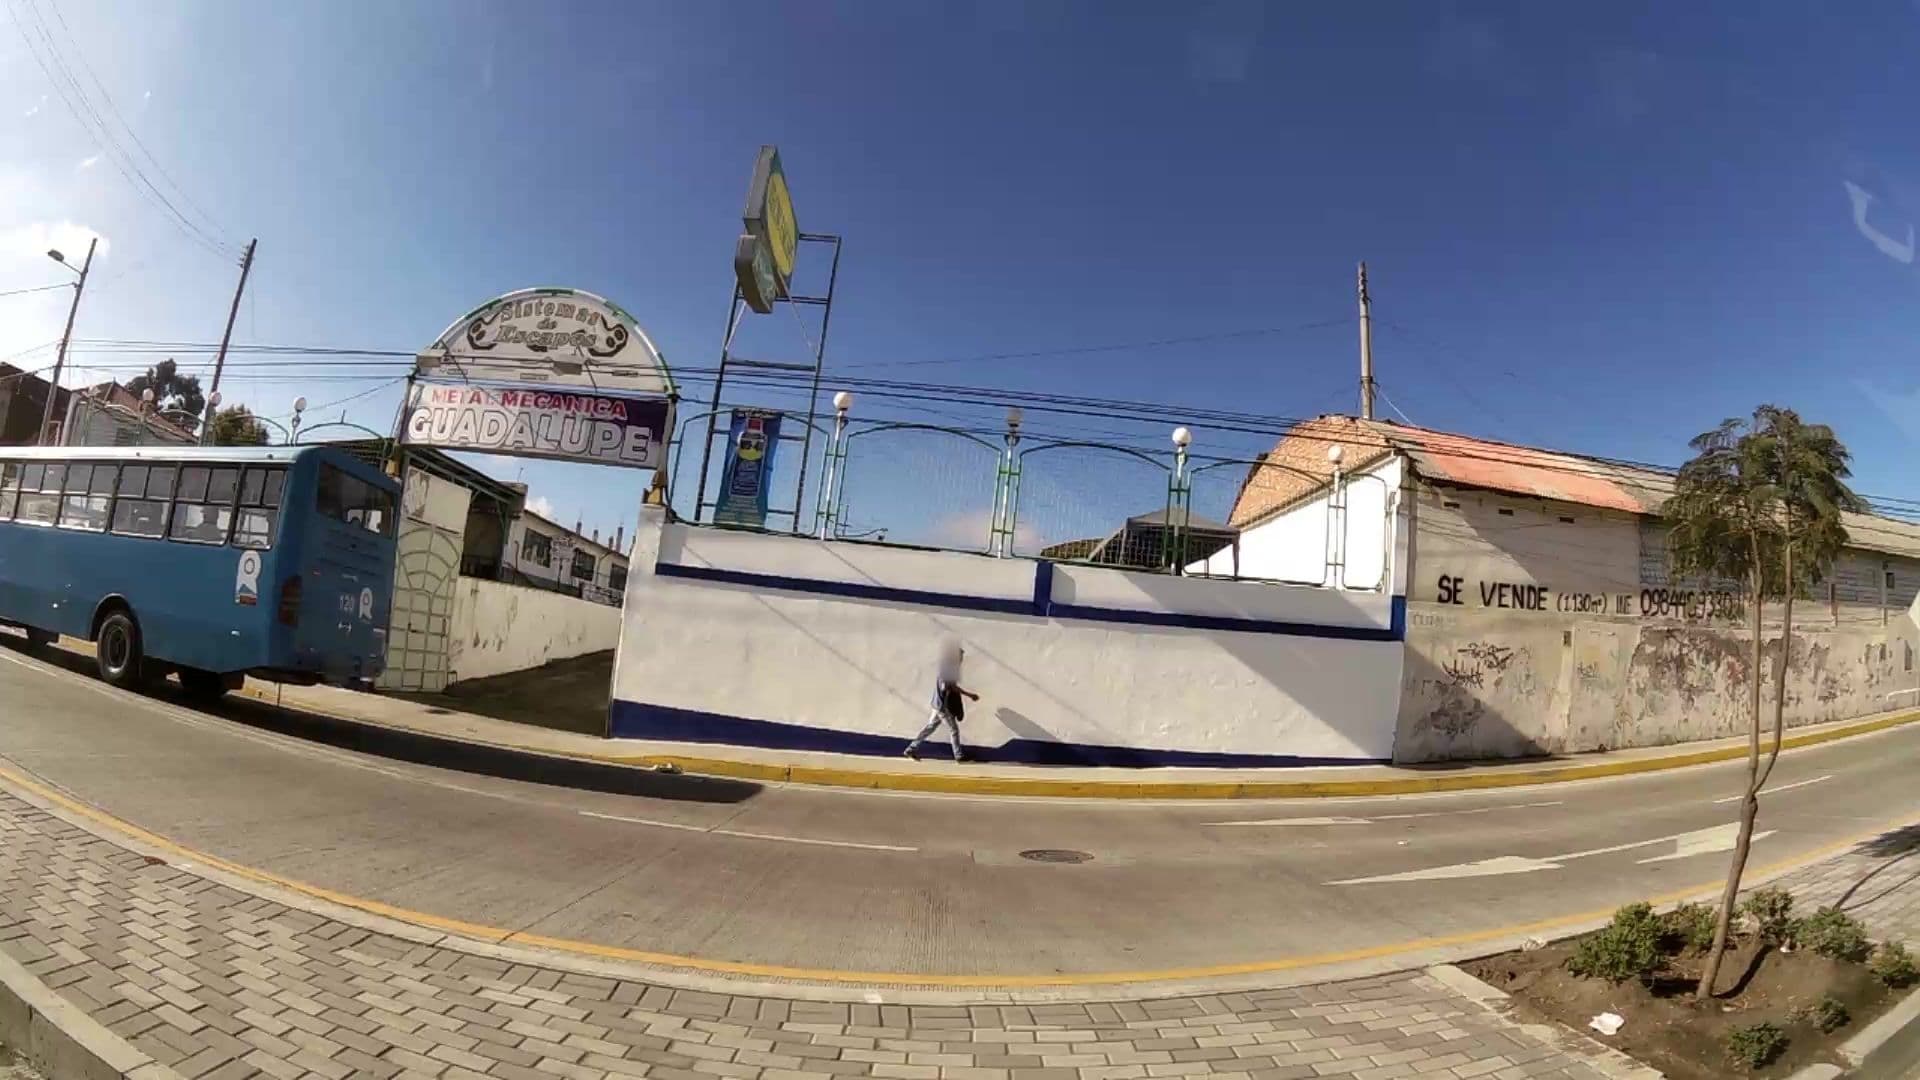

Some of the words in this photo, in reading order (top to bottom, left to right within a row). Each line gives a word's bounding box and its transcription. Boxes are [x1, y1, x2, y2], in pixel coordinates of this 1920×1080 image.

[408, 408, 650, 462] GUADALUPE
[1437, 574, 1464, 605] SE
[1480, 580, 1549, 611] VENDE
